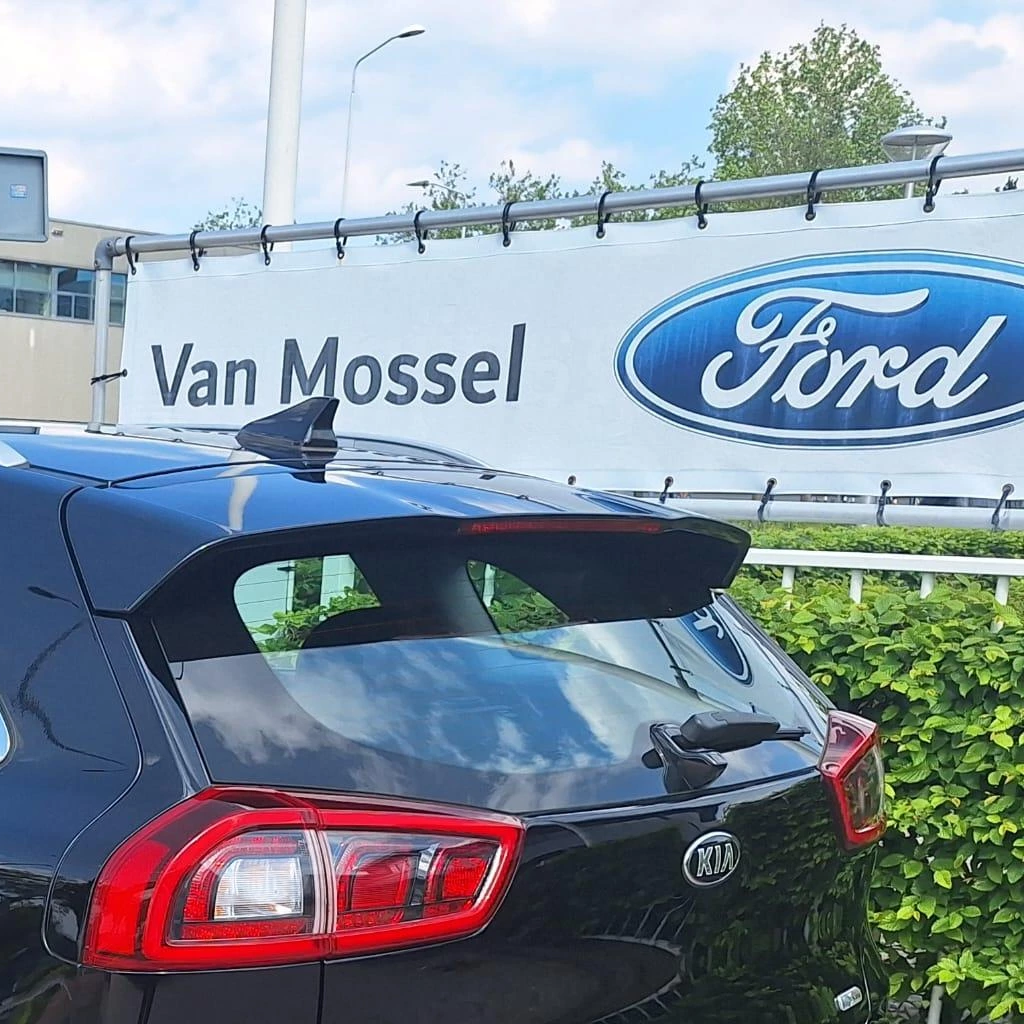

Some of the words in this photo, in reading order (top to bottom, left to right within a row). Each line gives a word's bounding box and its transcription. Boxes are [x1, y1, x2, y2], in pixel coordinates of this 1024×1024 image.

[151, 342, 257, 407] Van
[280, 323, 526, 405] Mossel
[701, 287, 1007, 409] Ford
[696, 843, 734, 877] KIA
